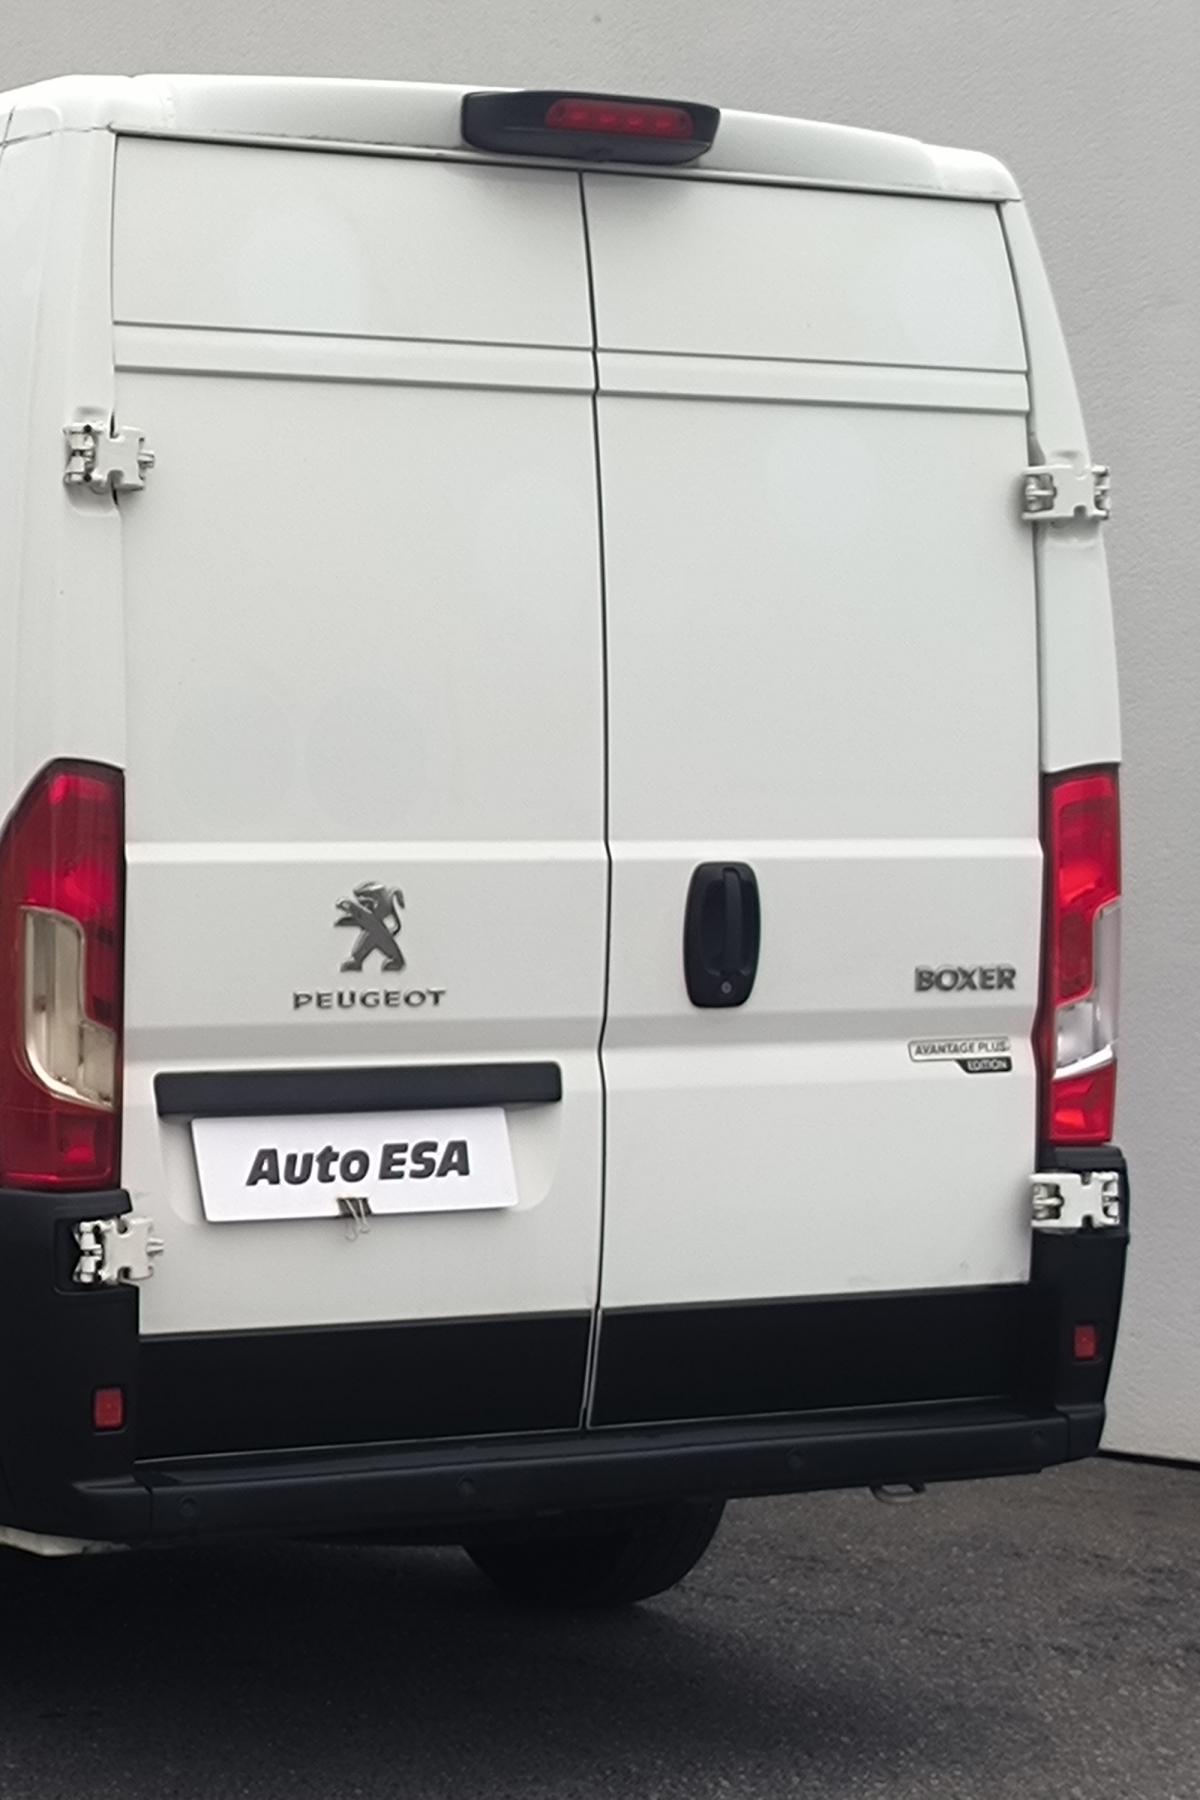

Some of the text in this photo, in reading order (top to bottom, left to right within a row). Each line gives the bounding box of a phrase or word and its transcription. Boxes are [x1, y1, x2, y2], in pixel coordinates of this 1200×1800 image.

[914, 965, 1016, 992] BOXER
[293, 989, 446, 1009] PEUGEOT
[914, 1041, 1008, 1055] AVANTAGE PLUS
[246, 1140, 470, 1186] Auto ESA
